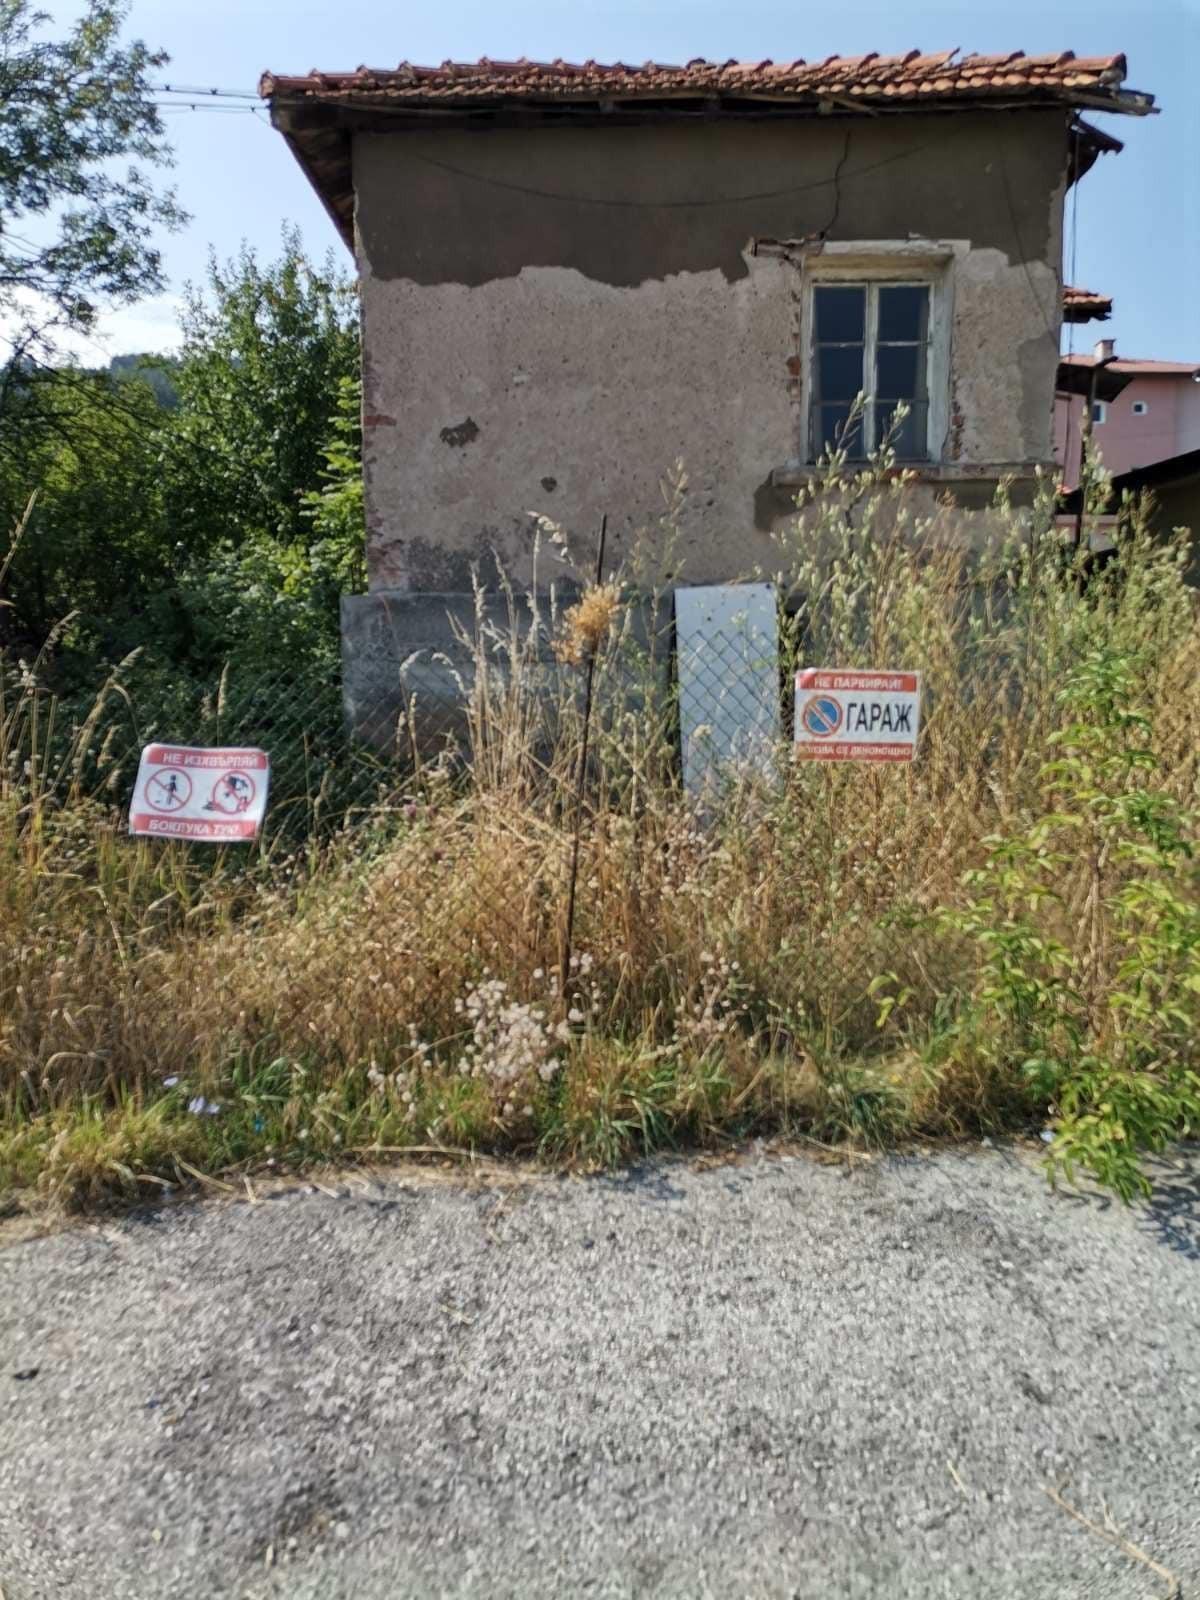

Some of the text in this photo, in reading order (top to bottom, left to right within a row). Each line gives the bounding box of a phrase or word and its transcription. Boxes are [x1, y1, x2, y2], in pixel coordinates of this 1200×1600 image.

[815, 678, 831, 689] НЕ
[846, 702, 913, 732] ГАРАЖ
[162, 752, 181, 763] НЕ
[149, 819, 209, 834] БОКЛУКА
